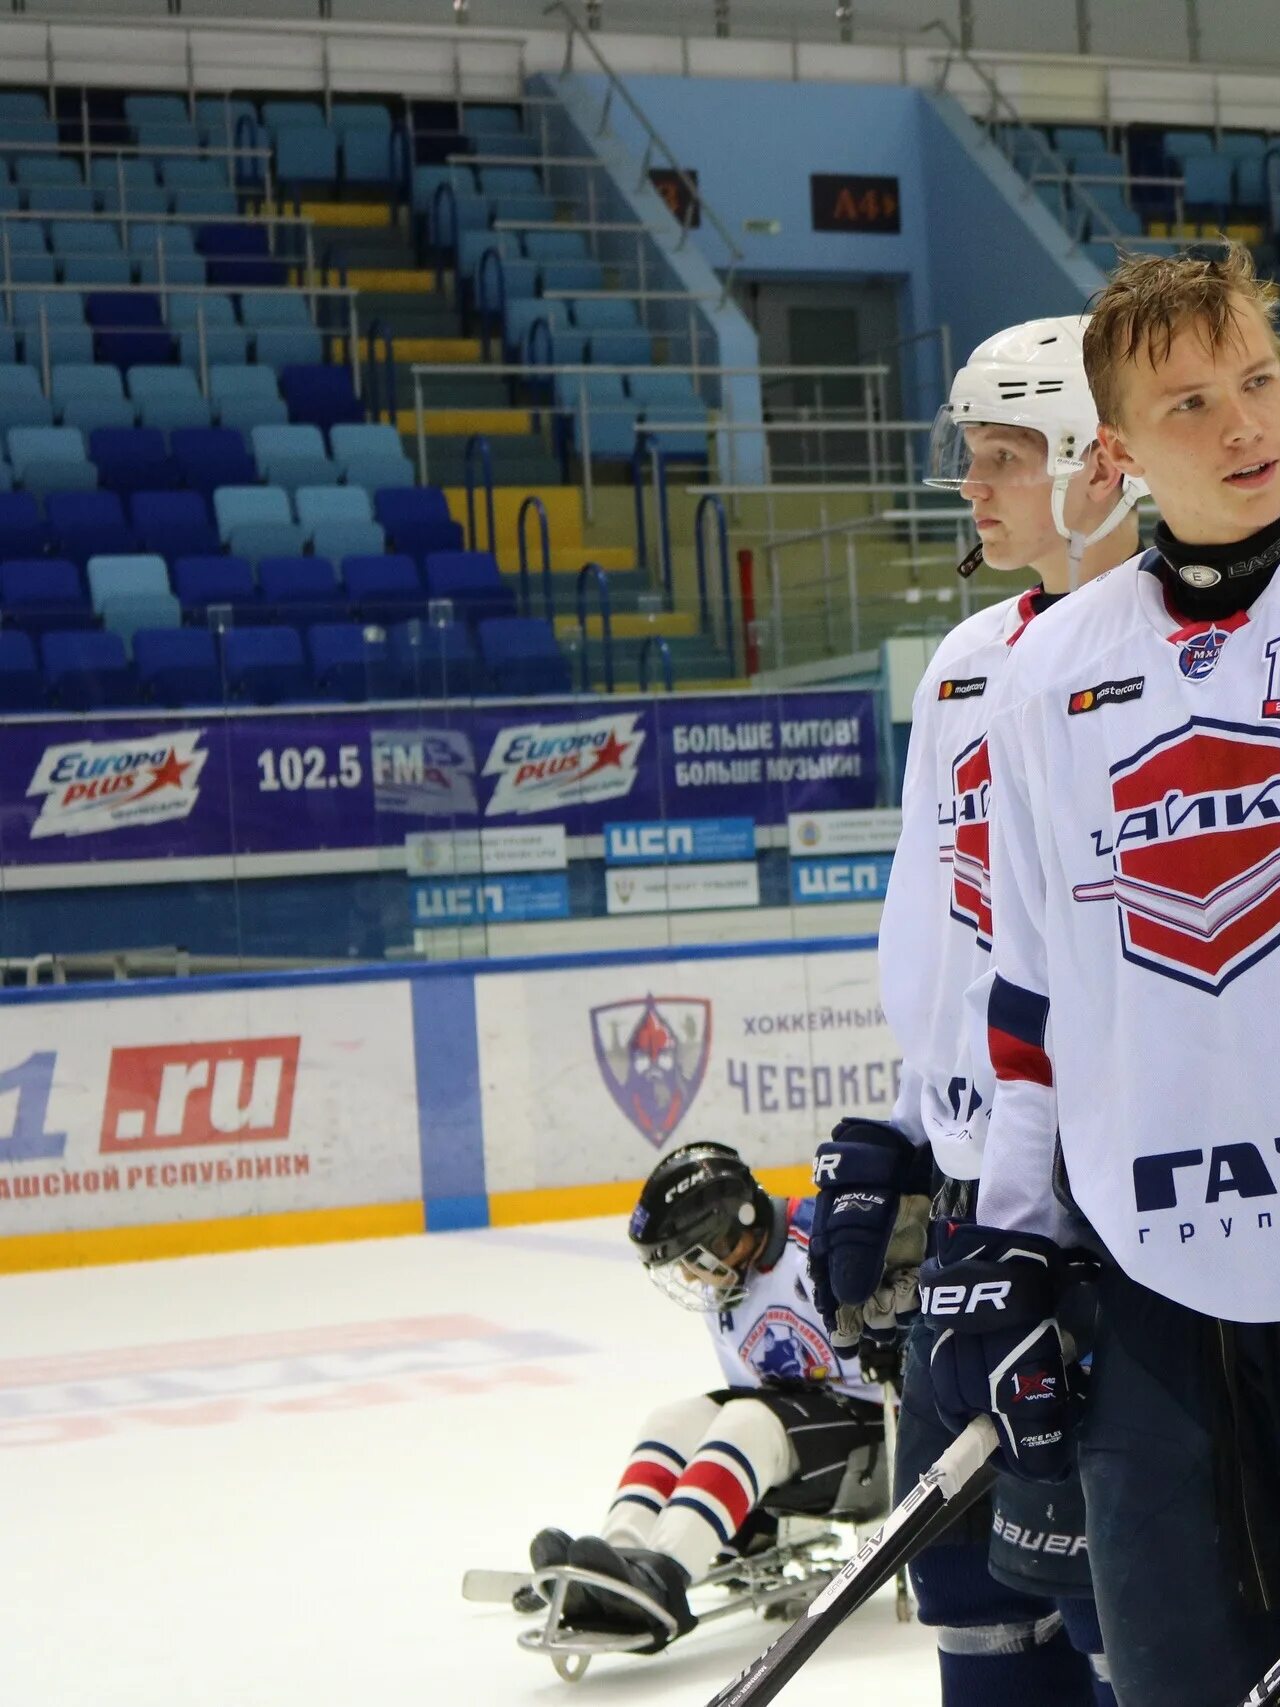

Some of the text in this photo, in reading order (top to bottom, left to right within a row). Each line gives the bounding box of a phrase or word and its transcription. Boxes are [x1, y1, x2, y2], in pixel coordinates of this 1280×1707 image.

[673, 721, 774, 754] БОЛЬШЕ
[49, 749, 168, 783] Europa
[257, 744, 362, 792] 102.5
[675, 758, 763, 787] БОЛЬШЕ
[610, 825, 694, 858] ЦСП
[799, 864, 878, 896] ЦСП
[126, 1153, 311, 1191] РЕСПУБЛИКИ
[832, 1192, 886, 1206] NEXUS
